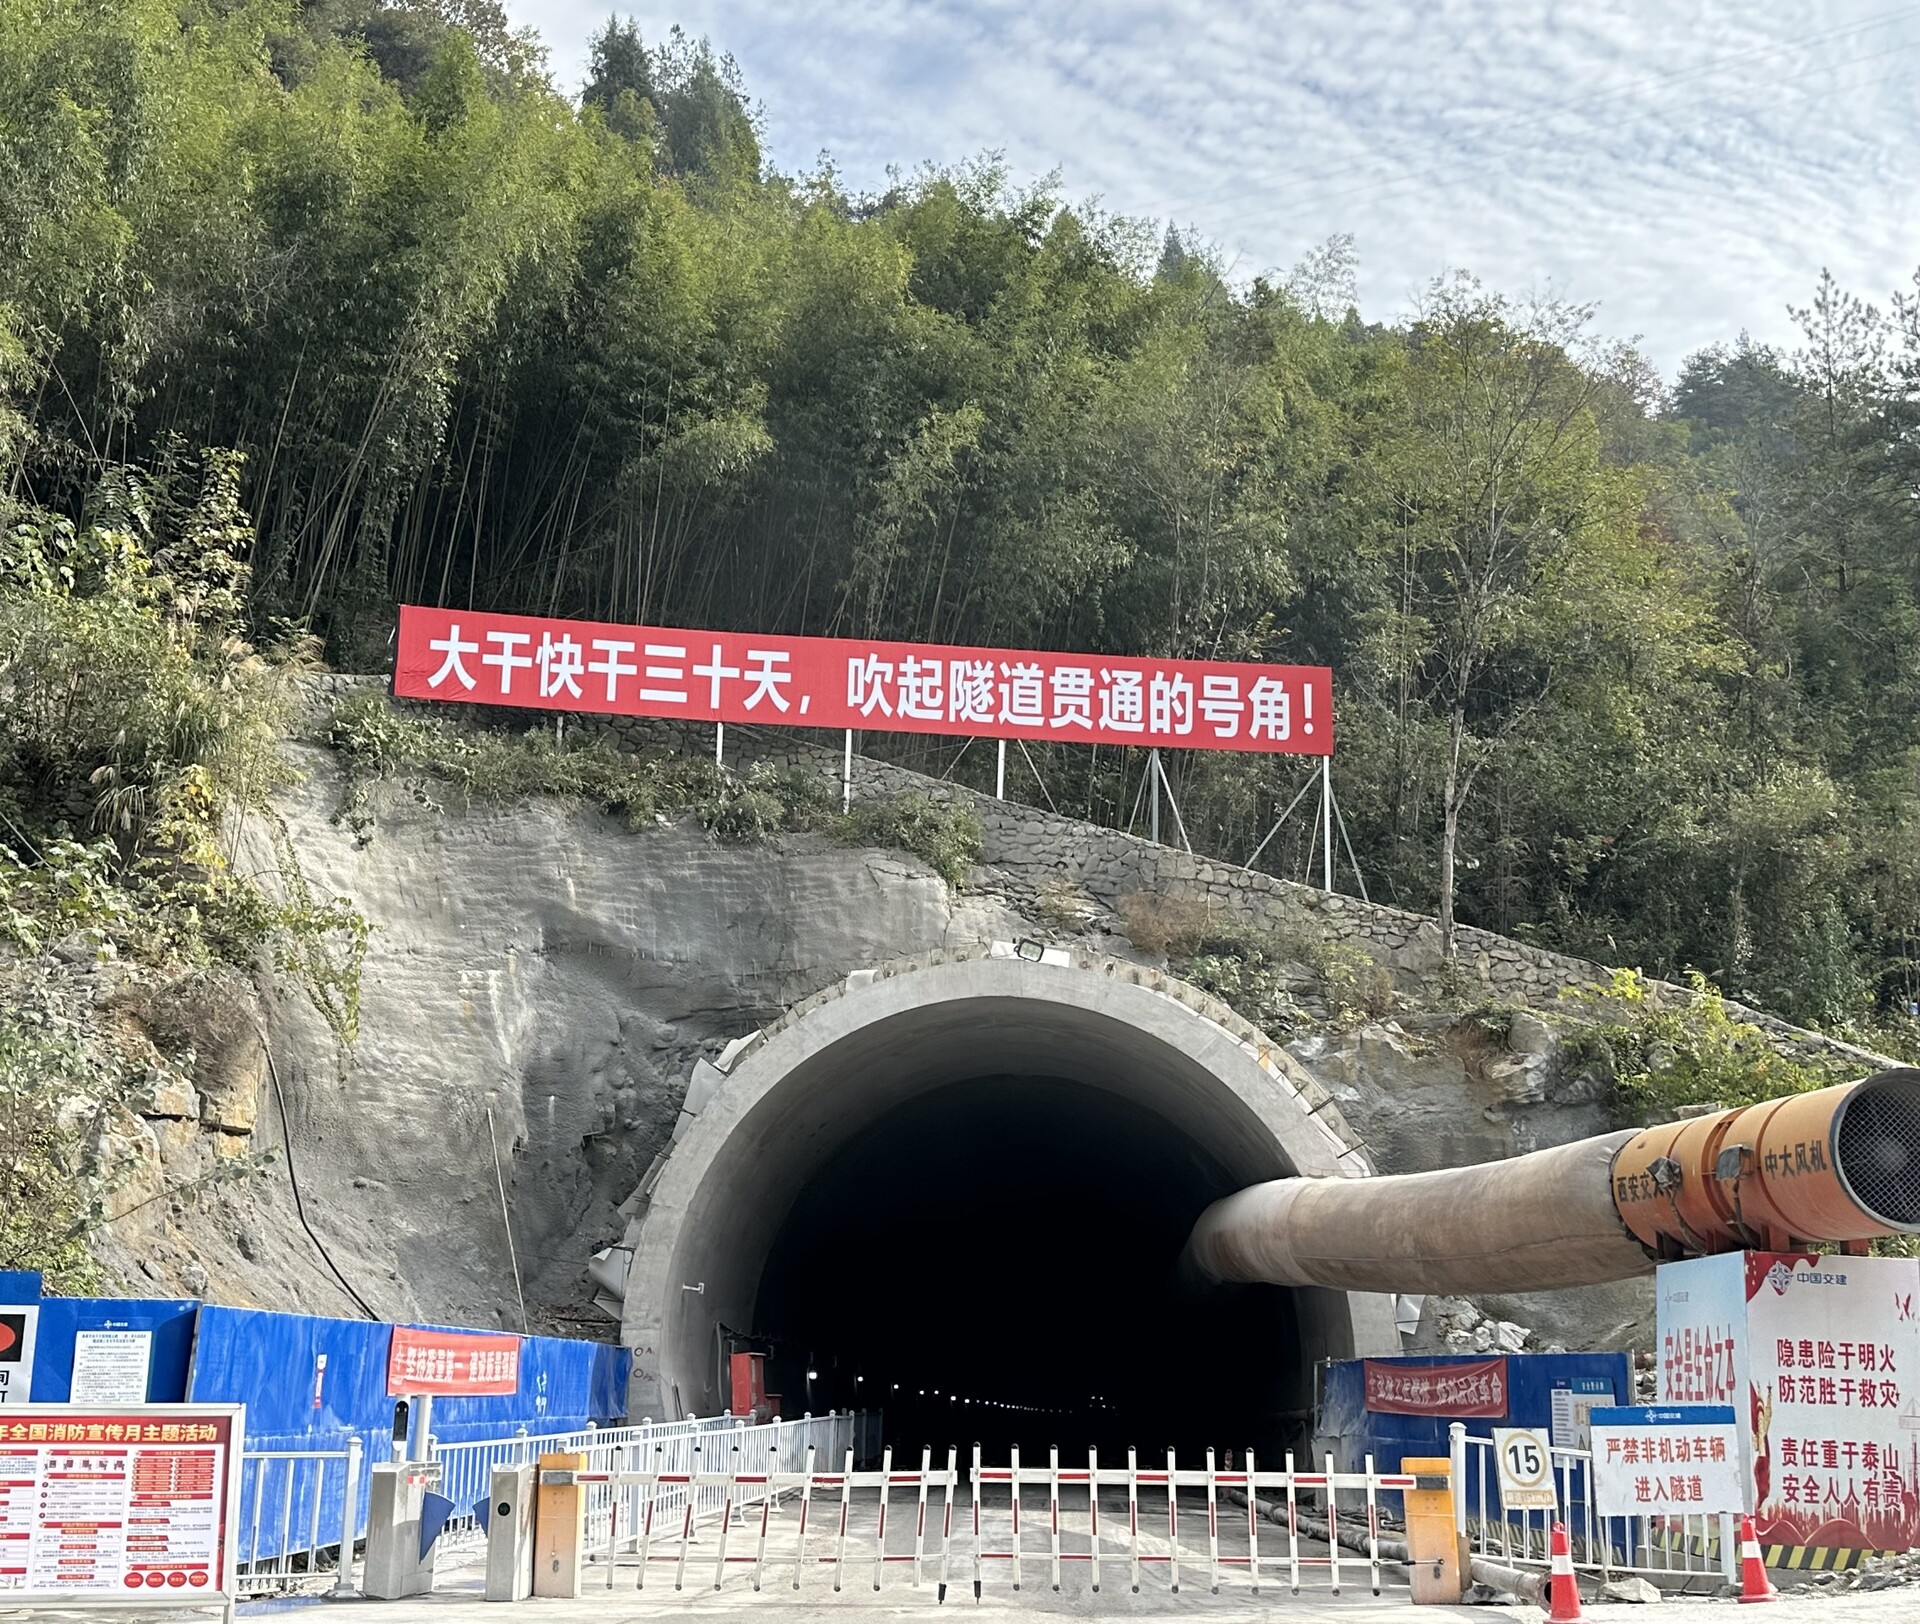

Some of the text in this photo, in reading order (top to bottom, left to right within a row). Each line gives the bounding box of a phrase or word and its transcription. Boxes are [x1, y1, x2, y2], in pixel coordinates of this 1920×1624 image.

[1764, 1140, 1827, 1180] 中大风机
[1797, 1272, 1847, 1285] 中国交建
[1665, 1323, 1736, 1404] 安全是生命之本
[1776, 1339, 1897, 1373] 隐患险于明火
[1778, 1375, 1898, 1408] 防范胜于救灾
[1508, 1445, 1540, 1474] 15
[1605, 1436, 1726, 1464] 严禁非机动车辆
[1781, 1437, 1899, 1471] 责任重于泰山
[1634, 1475, 1704, 1502] 进入隧道
[1782, 1473, 1901, 1510] 安全人人有责
